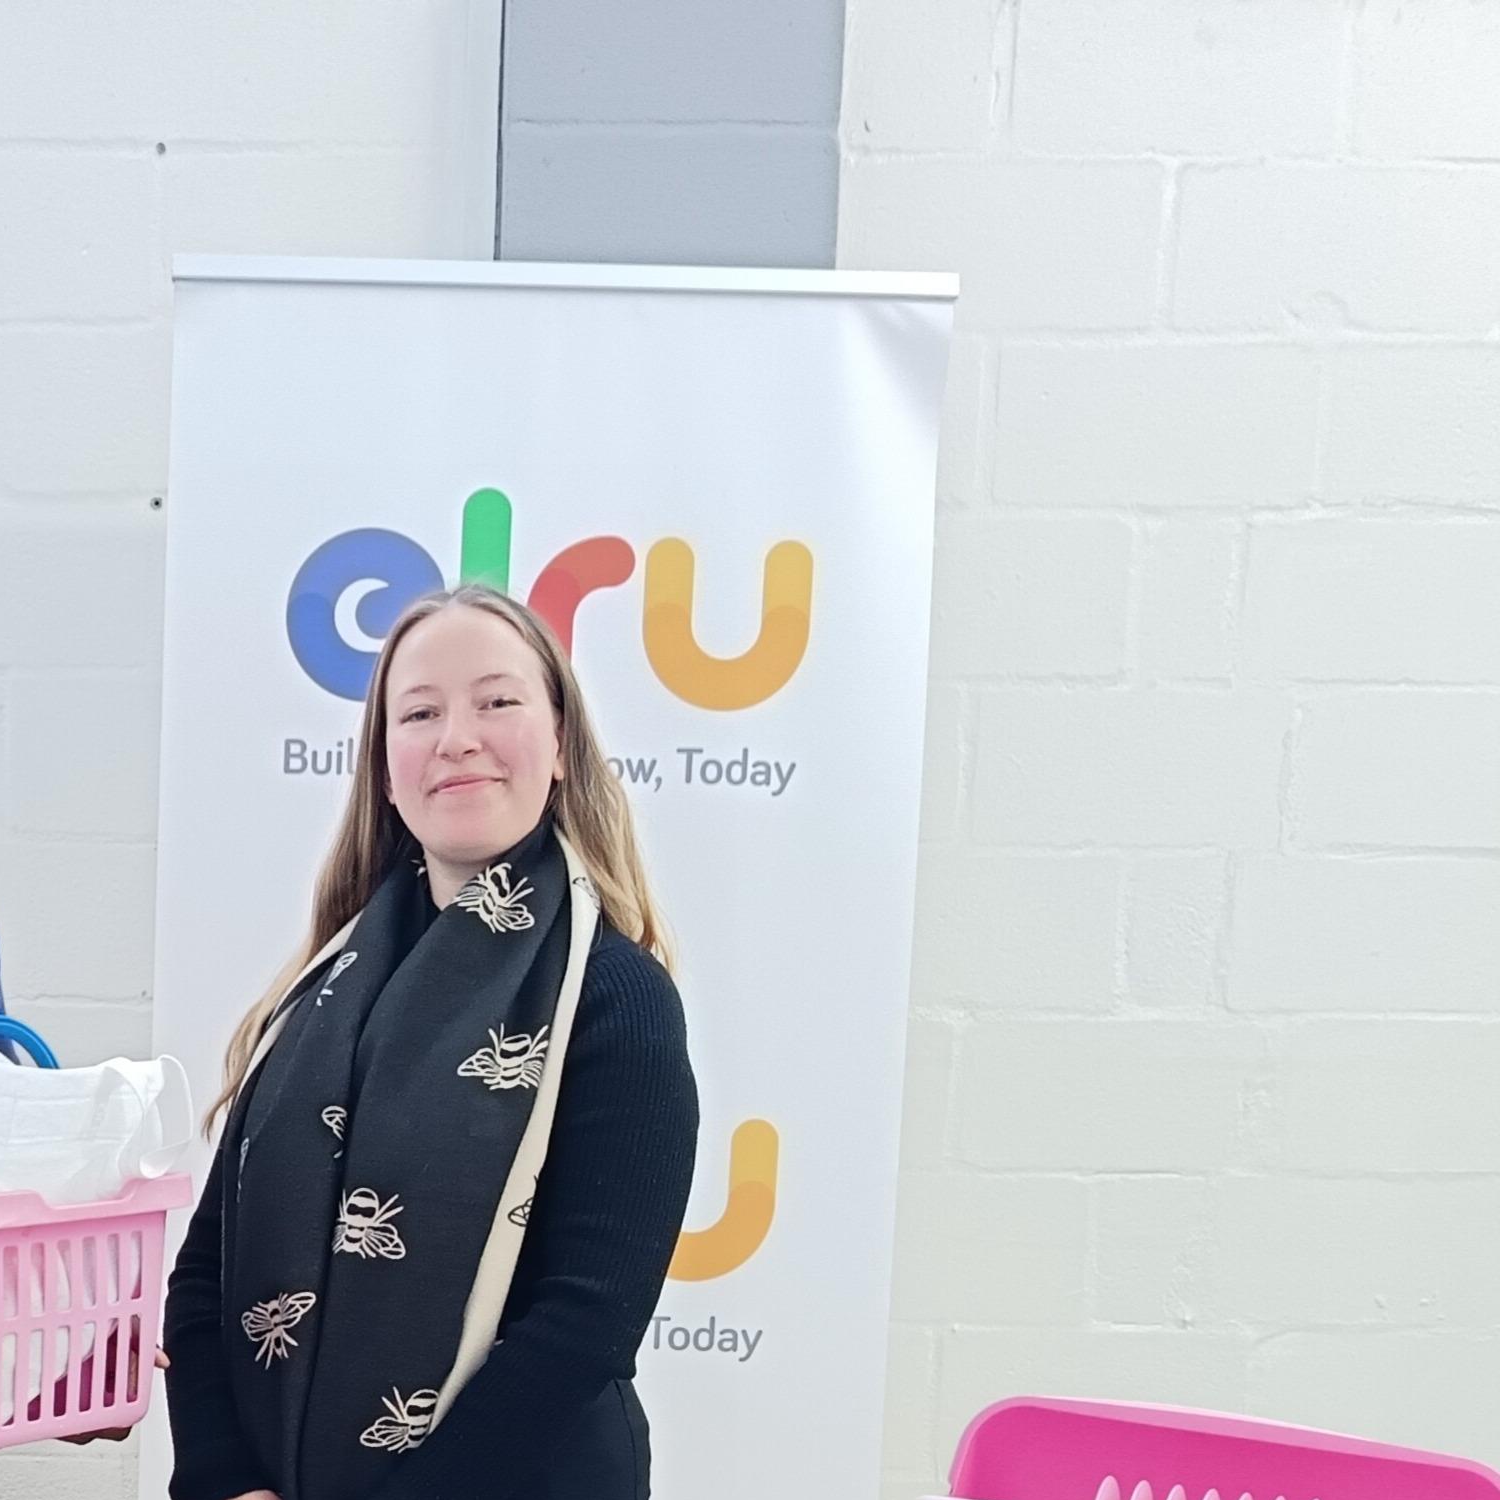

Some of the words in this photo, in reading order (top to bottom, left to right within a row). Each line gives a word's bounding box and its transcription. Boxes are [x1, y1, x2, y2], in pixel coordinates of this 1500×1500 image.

[283, 737, 356, 776] Buil
[676, 747, 797, 796] Today
[650, 1315, 763, 1362] Today
